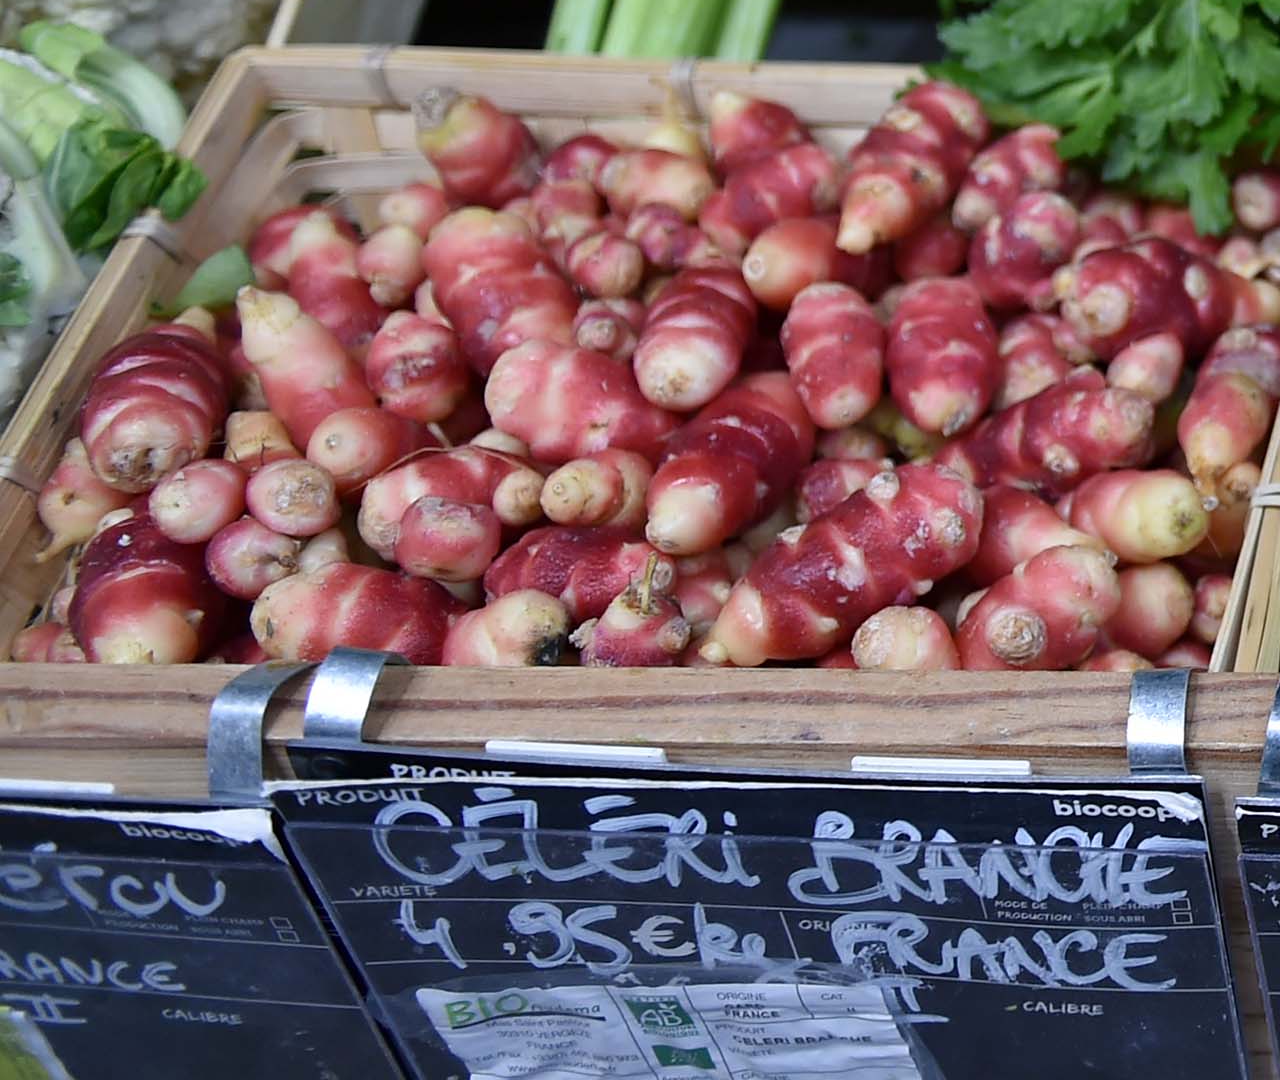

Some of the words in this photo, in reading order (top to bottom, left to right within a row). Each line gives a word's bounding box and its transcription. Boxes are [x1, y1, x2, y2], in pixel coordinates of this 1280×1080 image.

[294, 788, 424, 806] PRODUIT
[997, 911, 1073, 922] PRODUCTION
[162, 1008, 243, 1025] CALIBRE
[1023, 1001, 1105, 1016] CALIBRE
